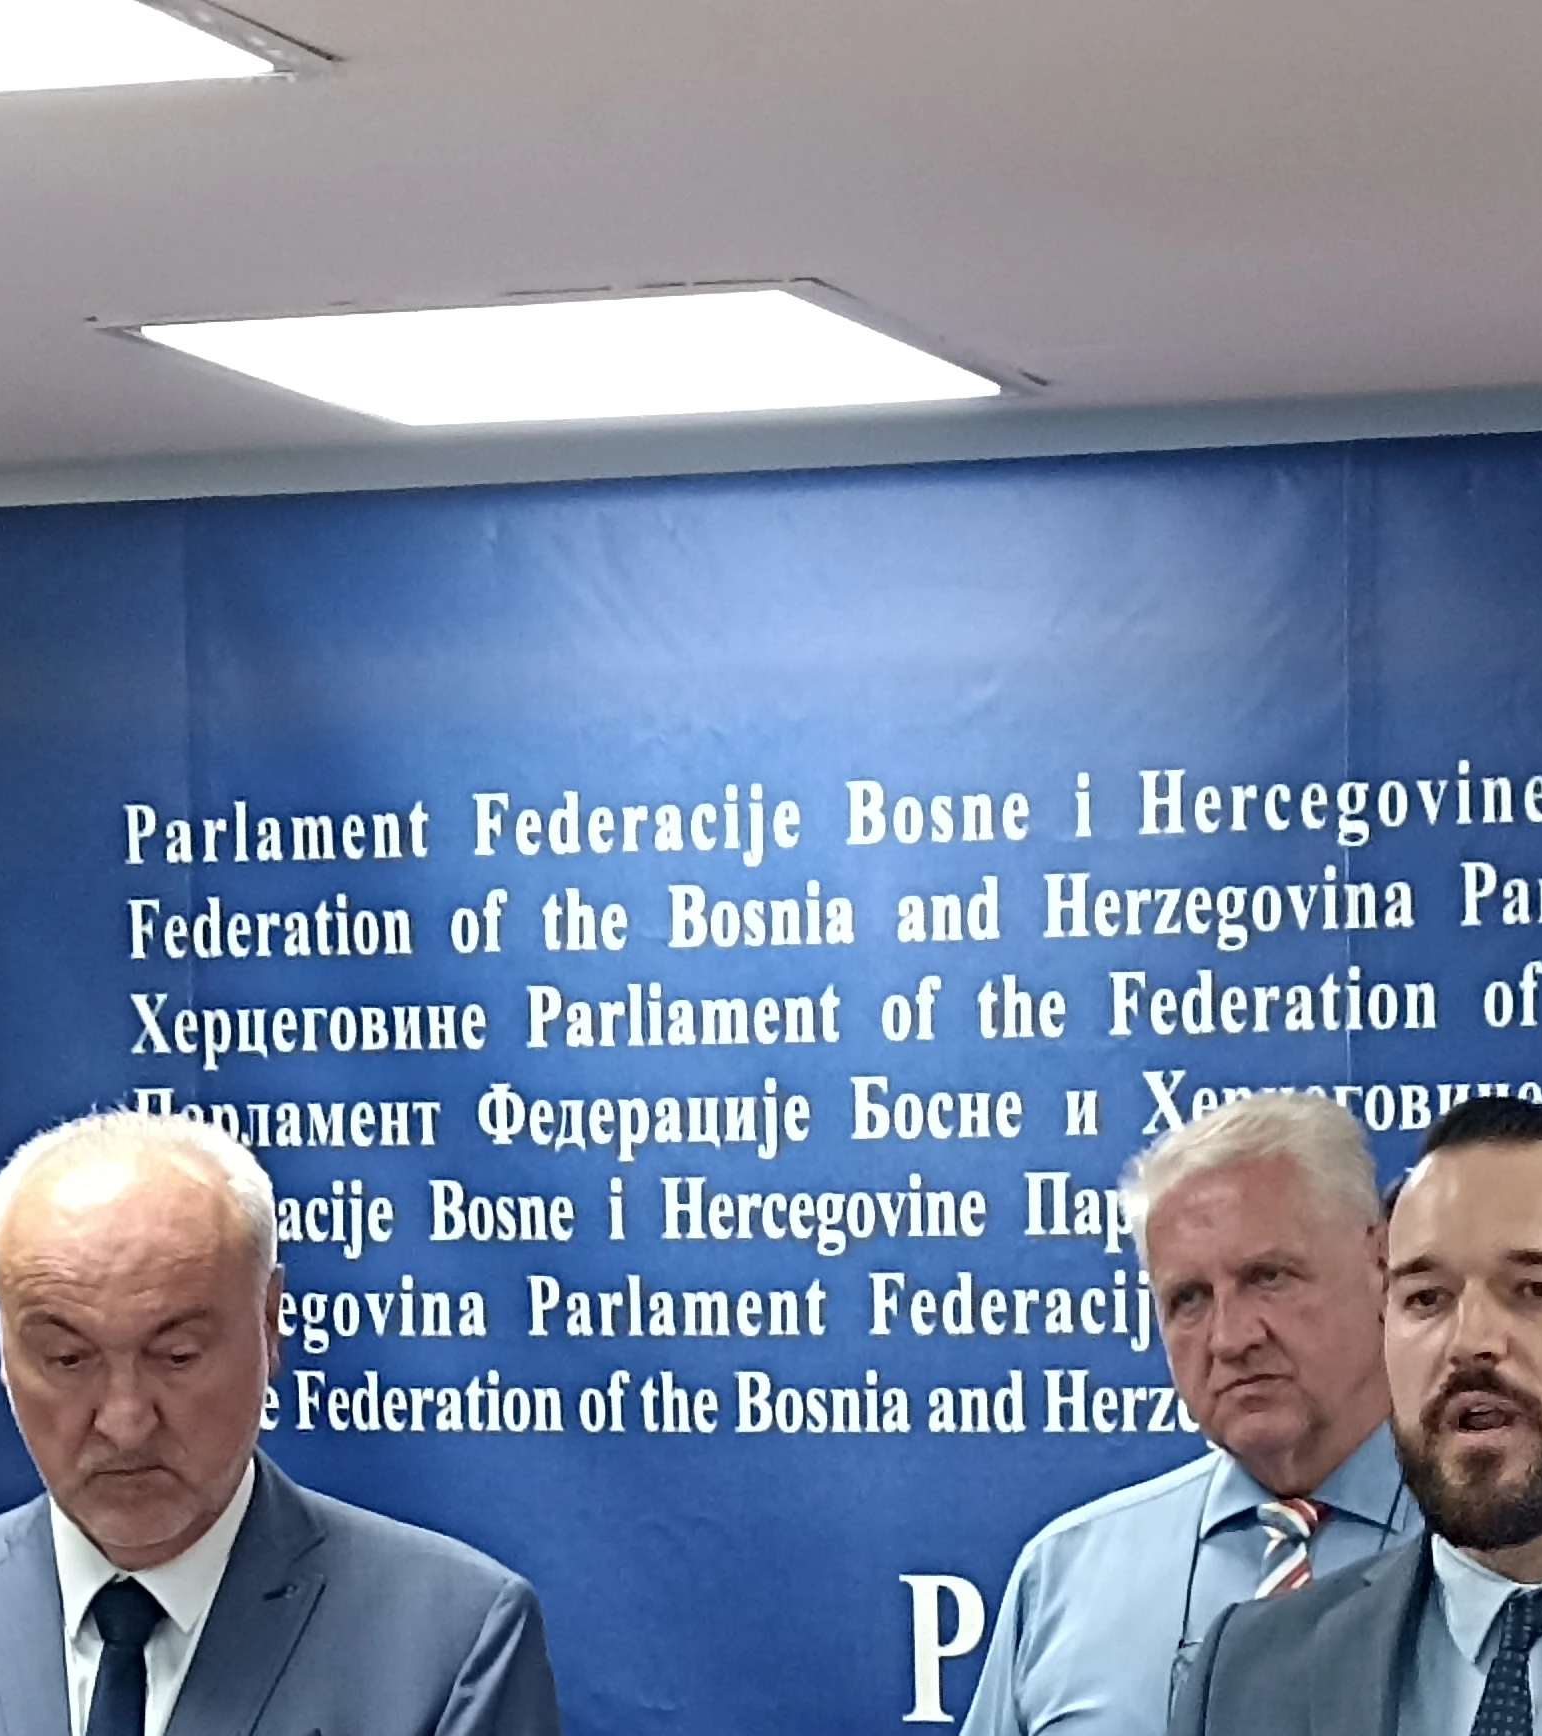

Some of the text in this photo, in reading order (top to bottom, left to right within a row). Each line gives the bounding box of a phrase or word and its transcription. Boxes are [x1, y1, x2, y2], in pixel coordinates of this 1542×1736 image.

[125, 801, 428, 864] Parlament
[473, 783, 800, 867] Federacije
[846, 781, 1029, 845] Bosne
[1076, 773, 1091, 837] i
[128, 894, 412, 958] Federation
[451, 889, 507, 953] of
[543, 888, 627, 950] the
[669, 880, 854, 948] Bosnia
[898, 876, 999, 942] and
[1043, 865, 1413, 951] Herzegovina
[131, 994, 486, 1070] Херцеговине
[527, 983, 840, 1047] Parliament
[882, 976, 941, 1041] of
[978, 975, 1065, 1038] the
[1109, 966, 1435, 1035] Federation
[479, 1078, 809, 1162] Федерације
[851, 1076, 1021, 1139] Босне
[1066, 1091, 1097, 1135] и
[278, 1179, 394, 1261] acije
[430, 1180, 574, 1241] Bosne
[610, 1178, 624, 1239] i
[661, 1173, 985, 1256] Hercegovine
[278, 1275, 486, 1353] egovina
[528, 1275, 826, 1336] Parlament
[869, 1268, 1151, 1352] Federacij
[294, 1370, 563, 1432] Federation
[580, 1370, 630, 1432] of
[641, 1372, 718, 1433] the
[735, 1370, 910, 1433] Bosnia
[929, 1370, 1025, 1432] and
